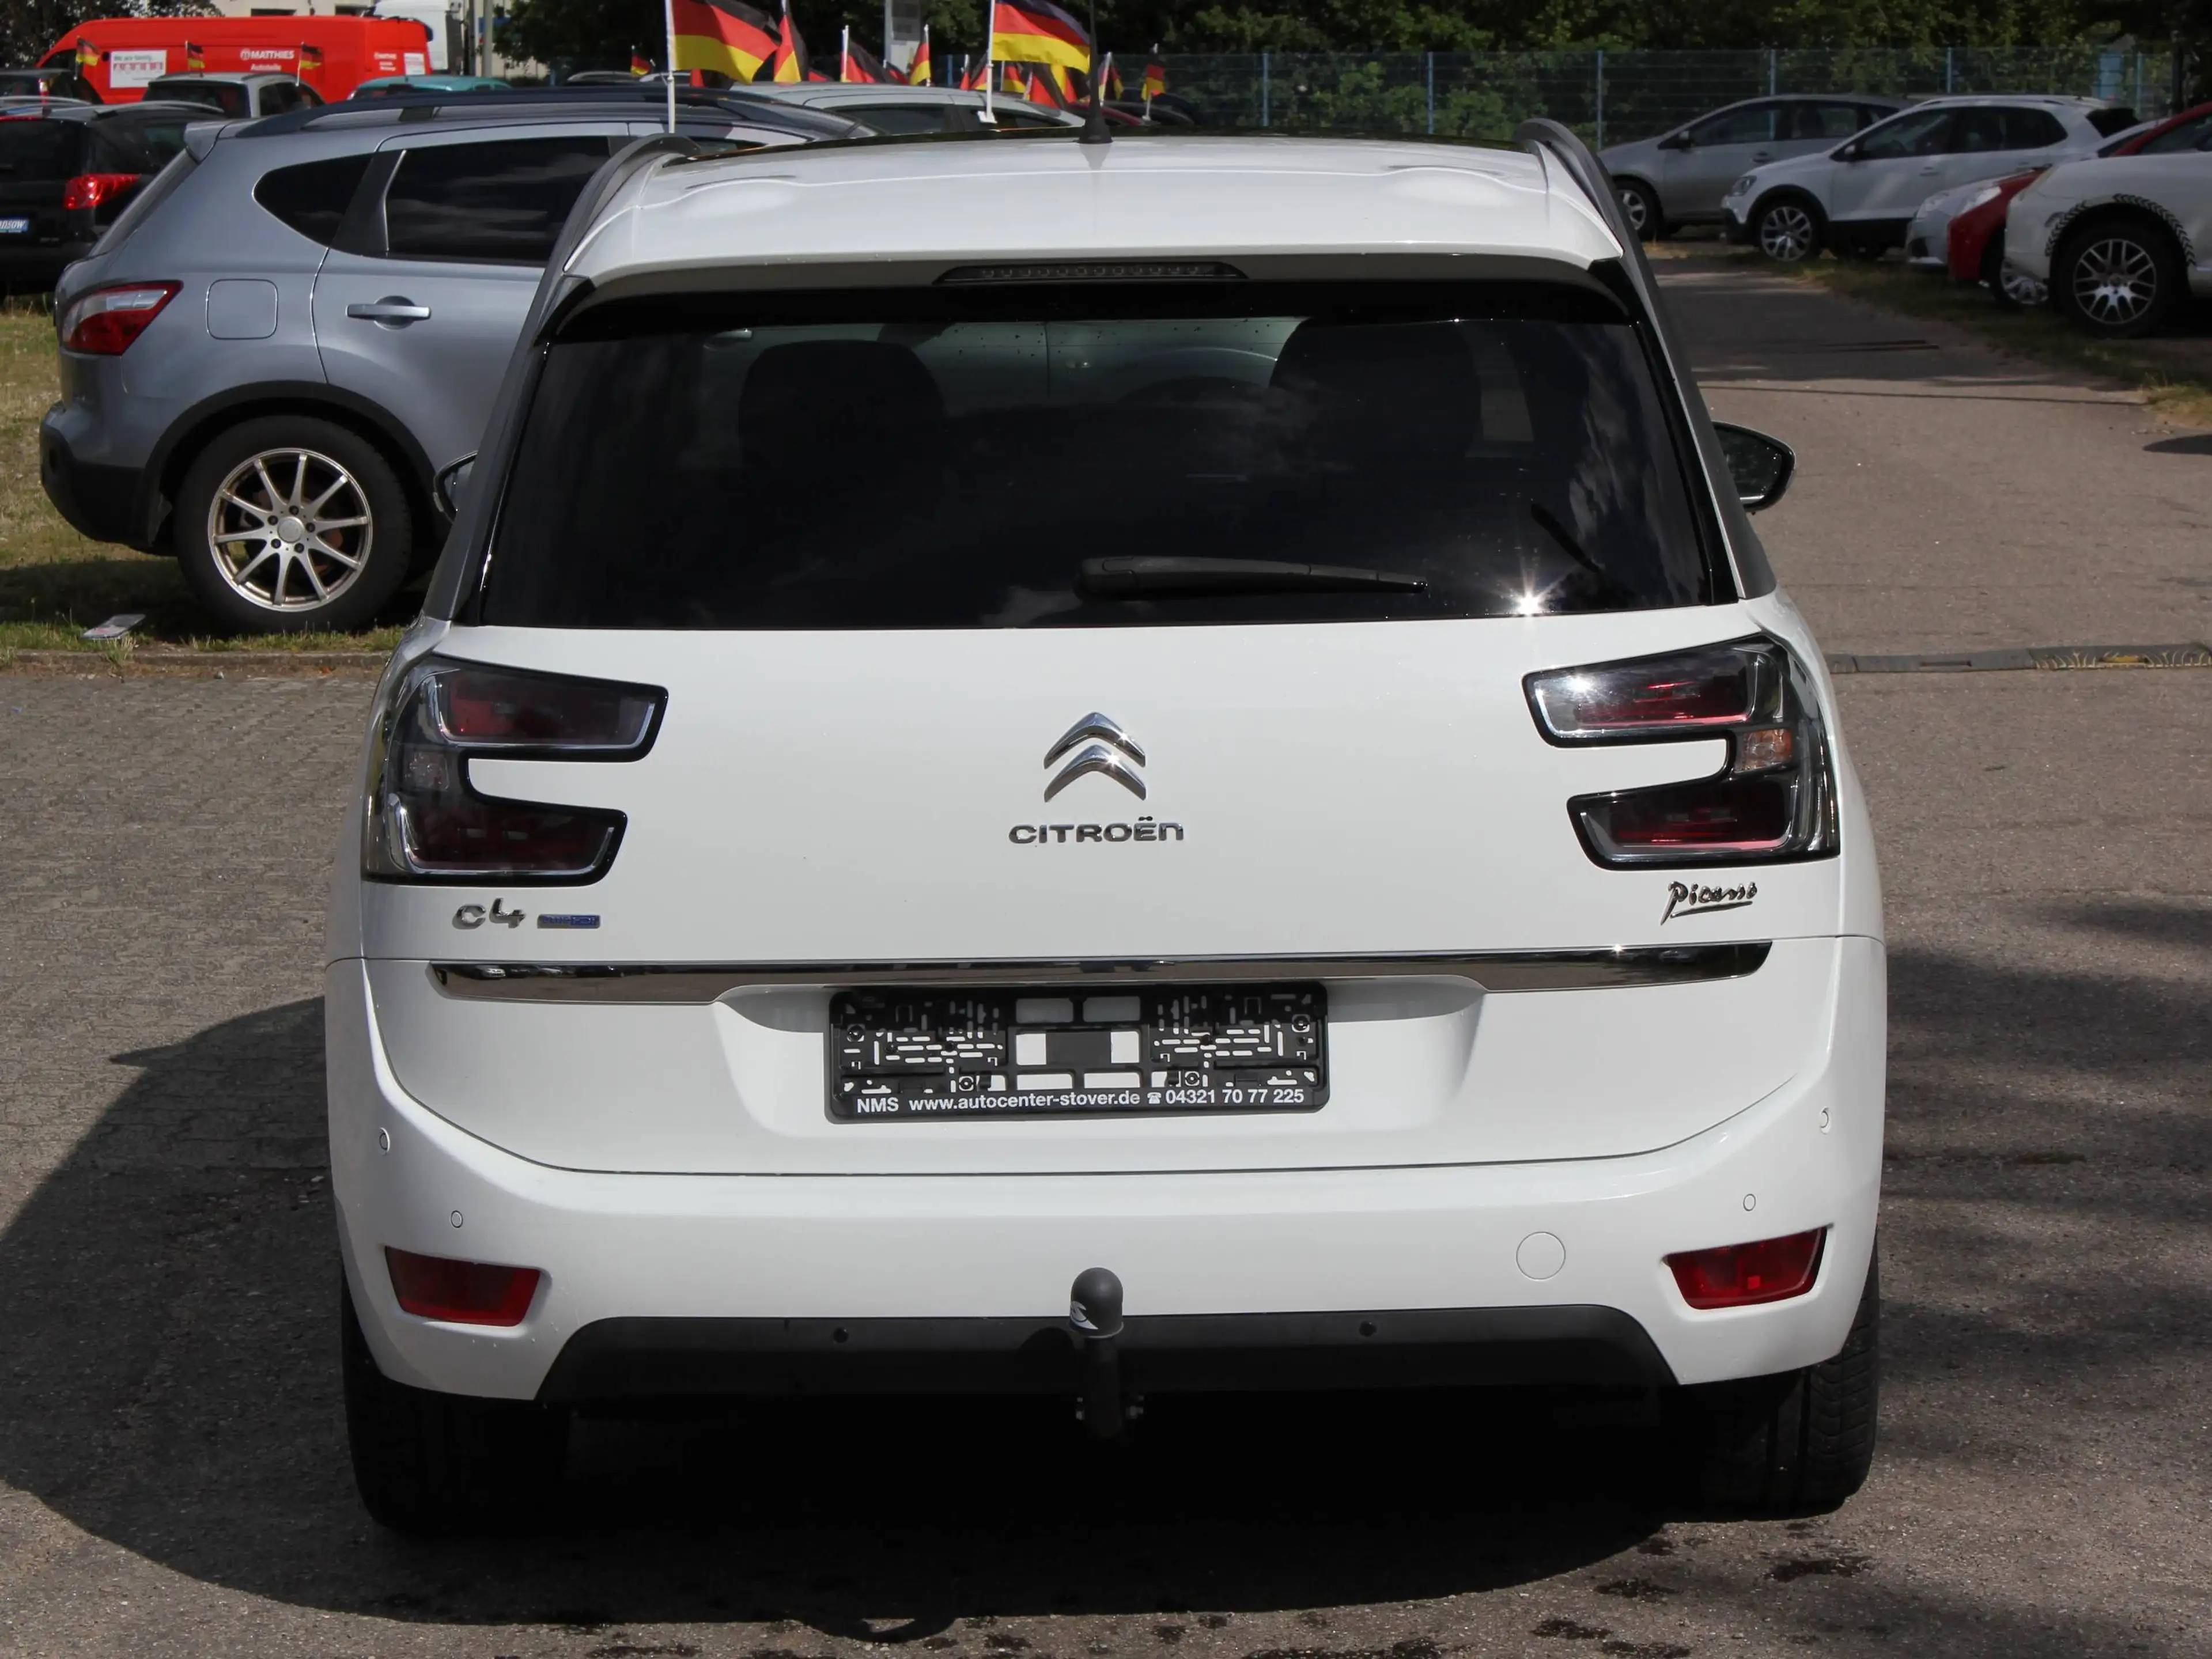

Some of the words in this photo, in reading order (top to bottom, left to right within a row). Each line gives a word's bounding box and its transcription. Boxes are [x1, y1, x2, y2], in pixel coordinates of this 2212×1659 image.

[251, 50, 294, 59] MATTHIES
[1009, 816, 1184, 843] CITROËN
[453, 897, 527, 929] C4
[1660, 881, 1758, 926] Picasso
[857, 1097, 899, 1113] NMS
[909, 1090, 1140, 1111] www.autocenter-stover.de
[1166, 1089, 1215, 1104] 04321
[1222, 1089, 1243, 1104] 70
[1247, 1089, 1268, 1104] 77
[1273, 1089, 1304, 1104] 225
